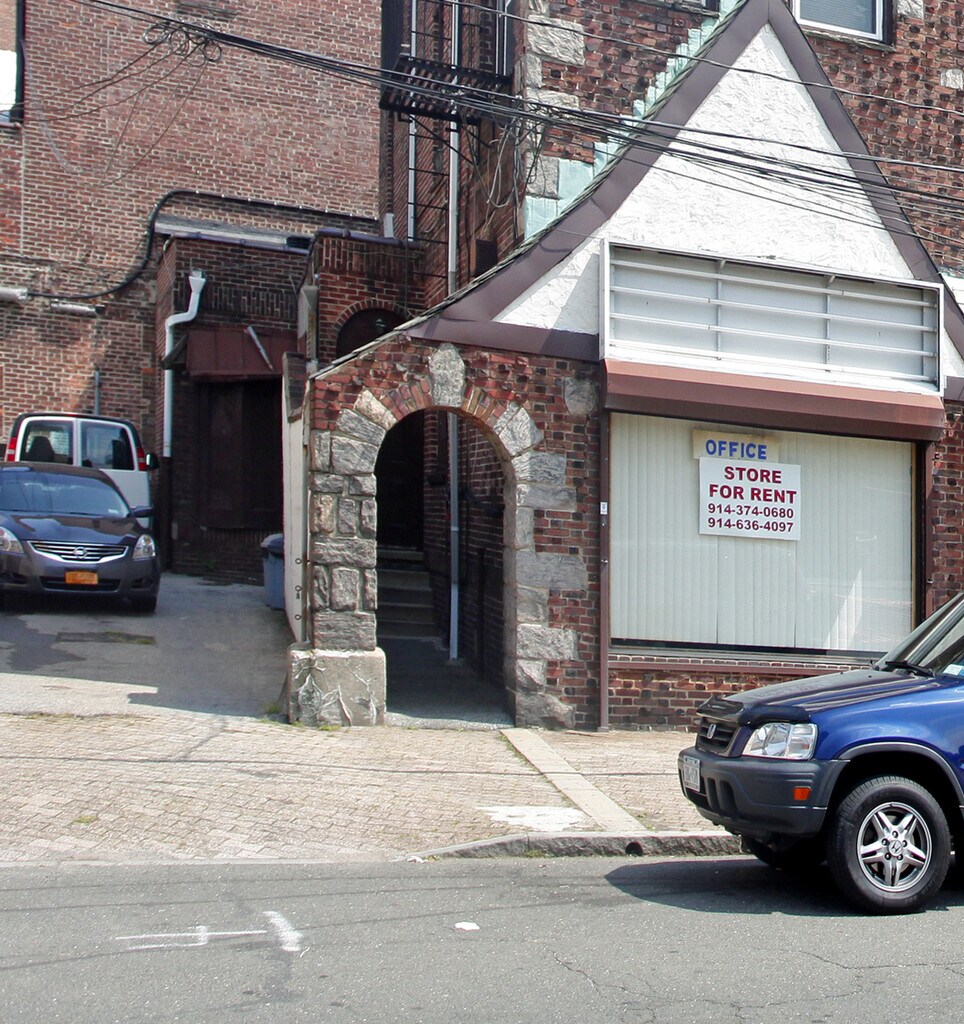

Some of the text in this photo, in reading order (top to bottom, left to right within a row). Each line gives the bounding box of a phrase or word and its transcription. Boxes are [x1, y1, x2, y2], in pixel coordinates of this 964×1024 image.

[705, 439, 767, 460] OFFICE
[724, 466, 782, 484] STORE
[709, 484, 797, 504] FOR RENT
[708, 503, 794, 519] 914-374-0680
[708, 517, 794, 532] 914-636-4097
